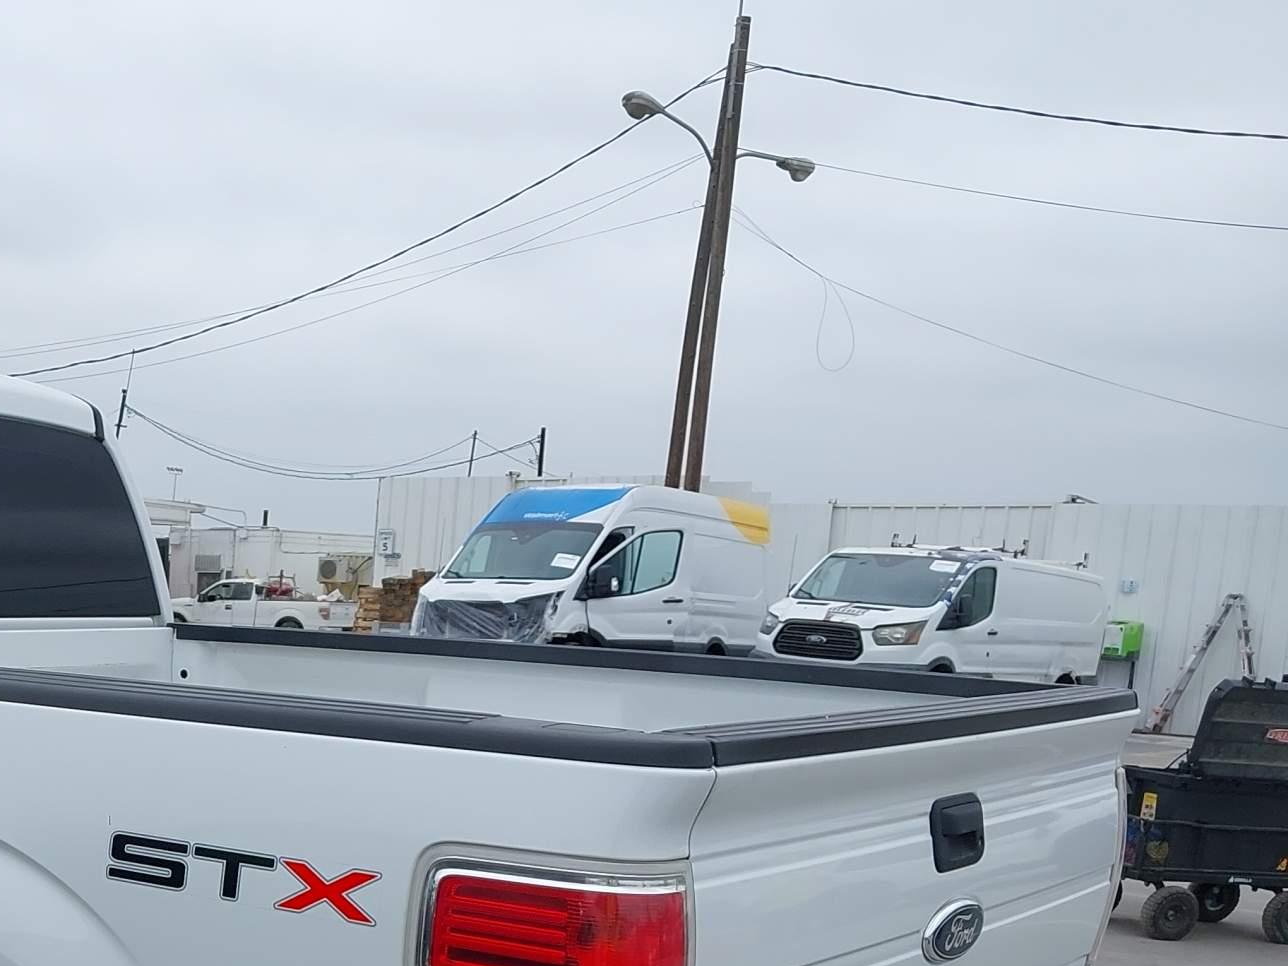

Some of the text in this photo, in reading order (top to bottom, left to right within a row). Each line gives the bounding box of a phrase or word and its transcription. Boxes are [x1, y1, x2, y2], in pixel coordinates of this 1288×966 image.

[381, 542, 389, 552] 5
[106, 831, 382, 927] STX
[944, 913, 979, 951] Ford
